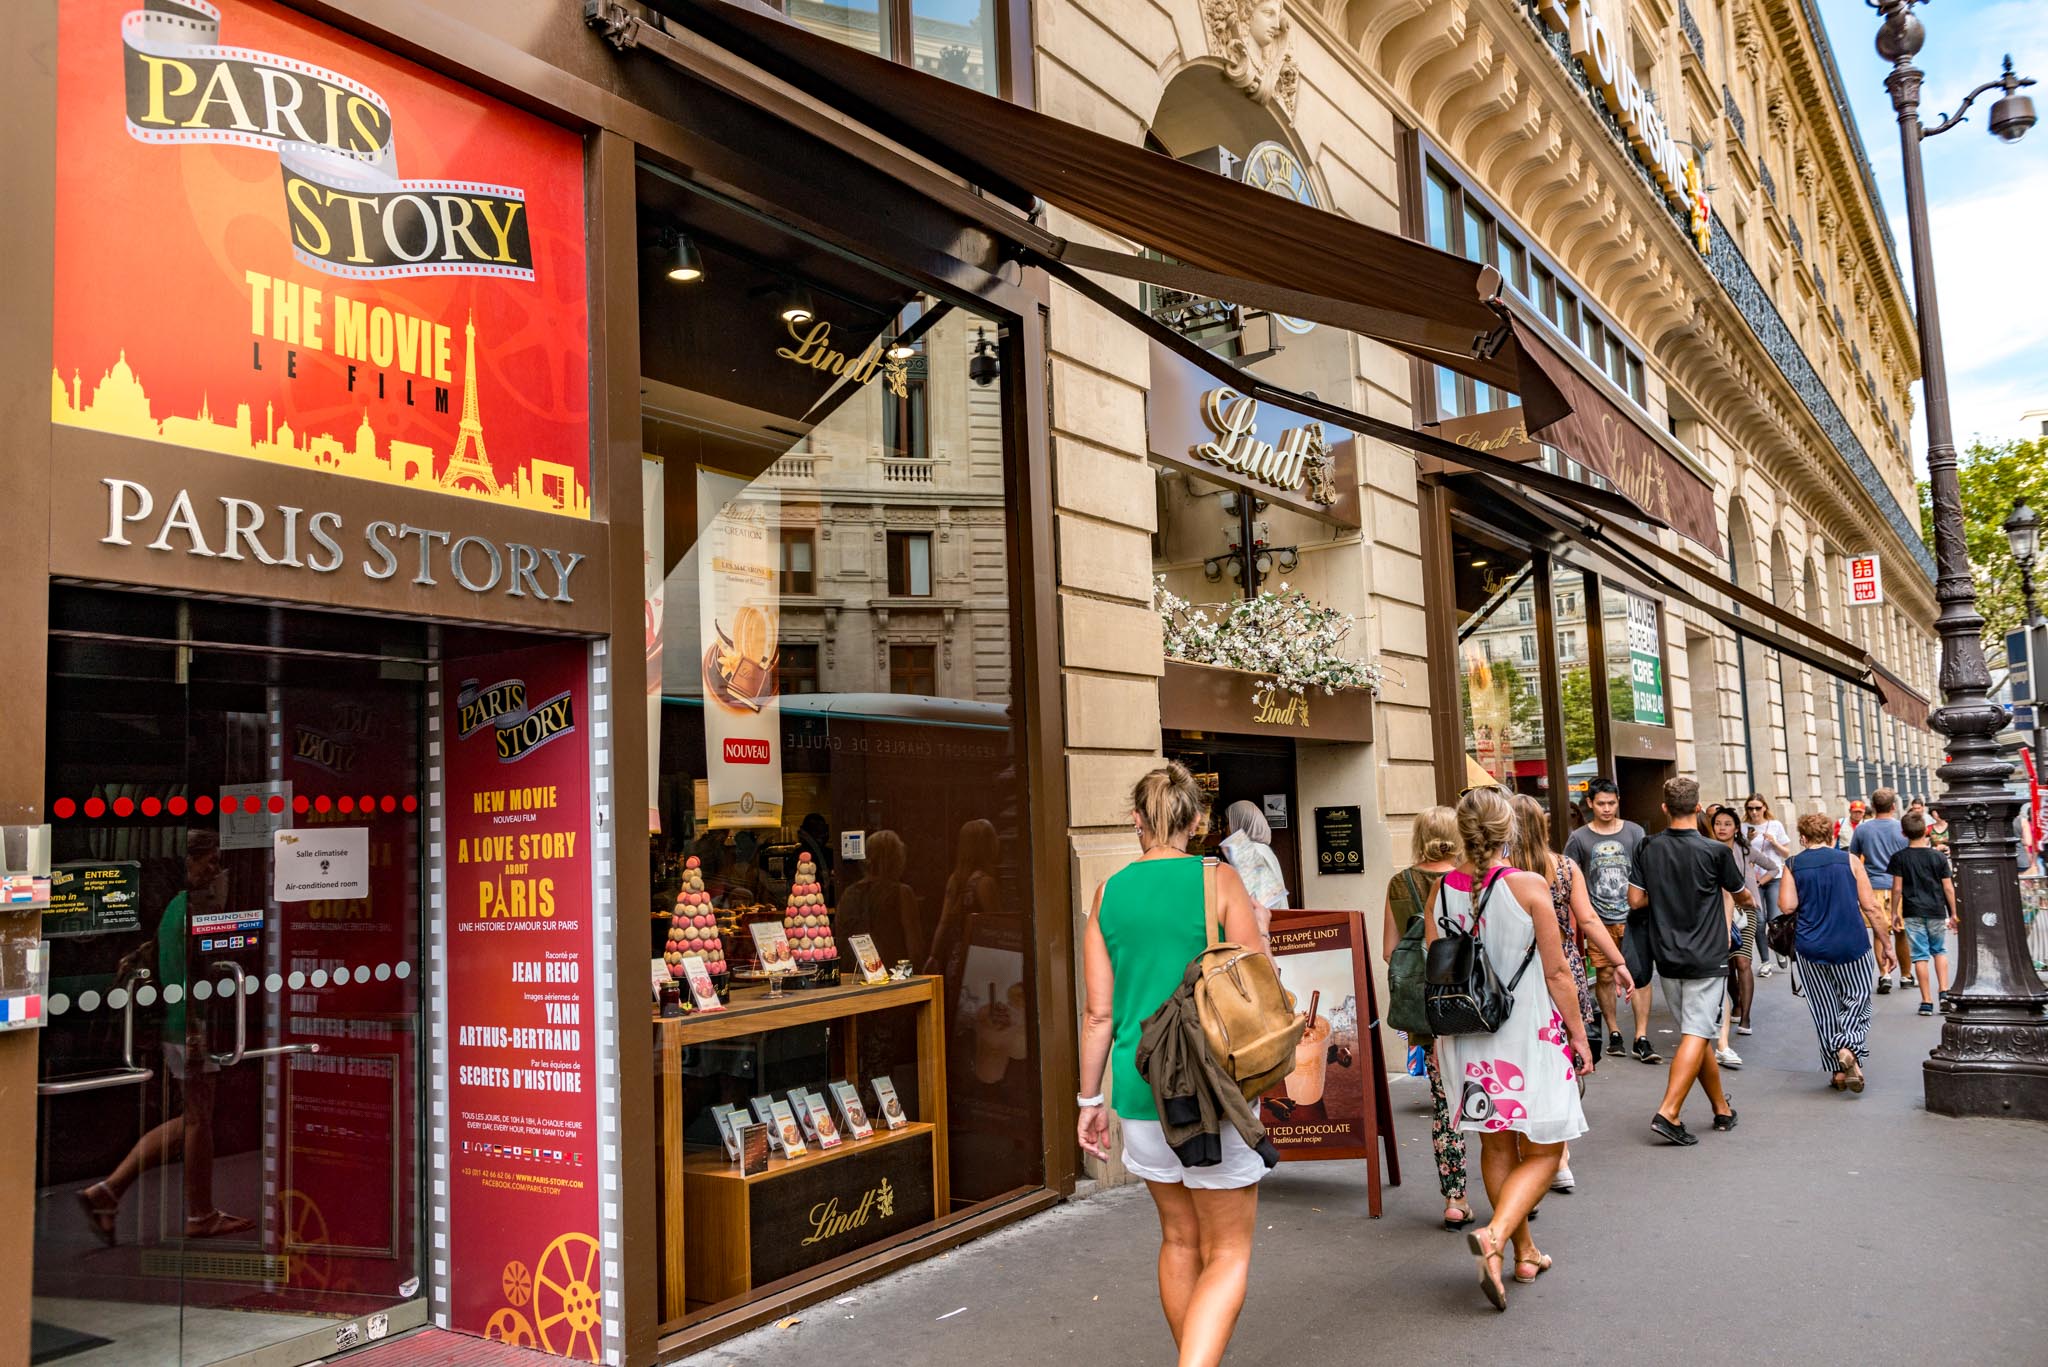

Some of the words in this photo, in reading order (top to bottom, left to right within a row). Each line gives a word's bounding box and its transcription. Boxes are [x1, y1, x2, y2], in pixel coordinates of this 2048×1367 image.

[139, 54, 383, 165] PARIS
[286, 177, 524, 264] STORY
[245, 270, 322, 351] THE
[334, 295, 452, 383] MOVIE
[776, 314, 884, 385] Lindt
[253, 342, 297, 379] LE
[348, 365, 449, 414] FILM
[1195, 387, 1310, 490] Lindt
[1456, 427, 1515, 452] Lindt
[1601, 413, 1655, 512] Lindt
[99, 477, 344, 573] PARIS
[362, 520, 587, 603] STORY
[1855, 583, 1873, 592] UNI
[1856, 590, 1874, 600] QLO
[1632, 658, 1654, 685] CBRE
[461, 684, 525, 734] PARIS
[1252, 689, 1299, 726] Lindt
[496, 696, 571, 758] STORY
[726, 744, 768, 759] NOUVEAU
[473, 789, 505, 813] NEW
[509, 786, 557, 810] MOVIE
[493, 814, 522, 824] NOUVEAU
[523, 813, 537, 823] FILM
[296, 850, 313, 858] Salle
[314, 849, 349, 857] climatisée
[458, 839, 469, 864] A
[474, 836, 514, 863] LOVE
[519, 831, 576, 861] STORY
[84, 870, 120, 879] ENTREZ
[505, 864, 528, 875] ABOUT
[285, 881, 339, 891] Air-conditioned
[68, 892, 77, 900] in
[479, 872, 555, 919] PARIS
[196, 911, 260, 923] GROUNDLINE
[458, 922, 473, 932] UNE
[474, 922, 506, 932] HISTOIRE
[542, 920, 557, 931] SUR
[557, 920, 579, 930] PARIS
[196, 923, 237, 933] EXCHANGE
[238, 921, 259, 929] POINT
[1282, 930, 1312, 943] FRAPPÉ
[1313, 928, 1339, 940] LINDT
[1279, 941, 1317, 951] traditionnelle
[545, 951, 568, 960] Raconté
[568, 952, 579, 961] par
[511, 962, 542, 983] JEAN
[545, 962, 579, 984] RENO
[524, 992, 544, 1002] Images
[544, 993, 572, 1002] aériennes
[572, 993, 580, 1002] de
[545, 1002, 580, 1025] YANN
[459, 1025, 581, 1052] ARTHUS-BERTRAND
[530, 1059, 541, 1068] Par
[542, 1060, 550, 1069] les
[550, 1060, 573, 1071] équipes
[573, 1062, 581, 1070] de
[459, 1065, 510, 1088] SECRETS
[461, 1112, 476, 1120] TOUS
[475, 1113, 485, 1121] LES
[502, 1115, 510, 1123] DE
[510, 1115, 520, 1124] 10H
[542, 1118, 565, 1128] CHAQUE
[564, 1120, 583, 1130] HEURE
[467, 1121, 482, 1130] EVERY
[493, 1123, 509, 1132] EVERY
[525, 1126, 542, 1135] FROM
[542, 1127, 556, 1137] 10AM
[556, 1129, 565, 1137] TO
[565, 1129, 577, 1139] 6PM
[1273, 1126, 1293, 1136] ICED
[1295, 1123, 1351, 1135] CHOCOLATE
[1272, 1136, 1303, 1144] Traditional
[1303, 1136, 1322, 1144] recipe
[515, 1173, 584, 1189] WWW.PARIS-STORY.COM
[800, 1189, 878, 1248] Lindt
